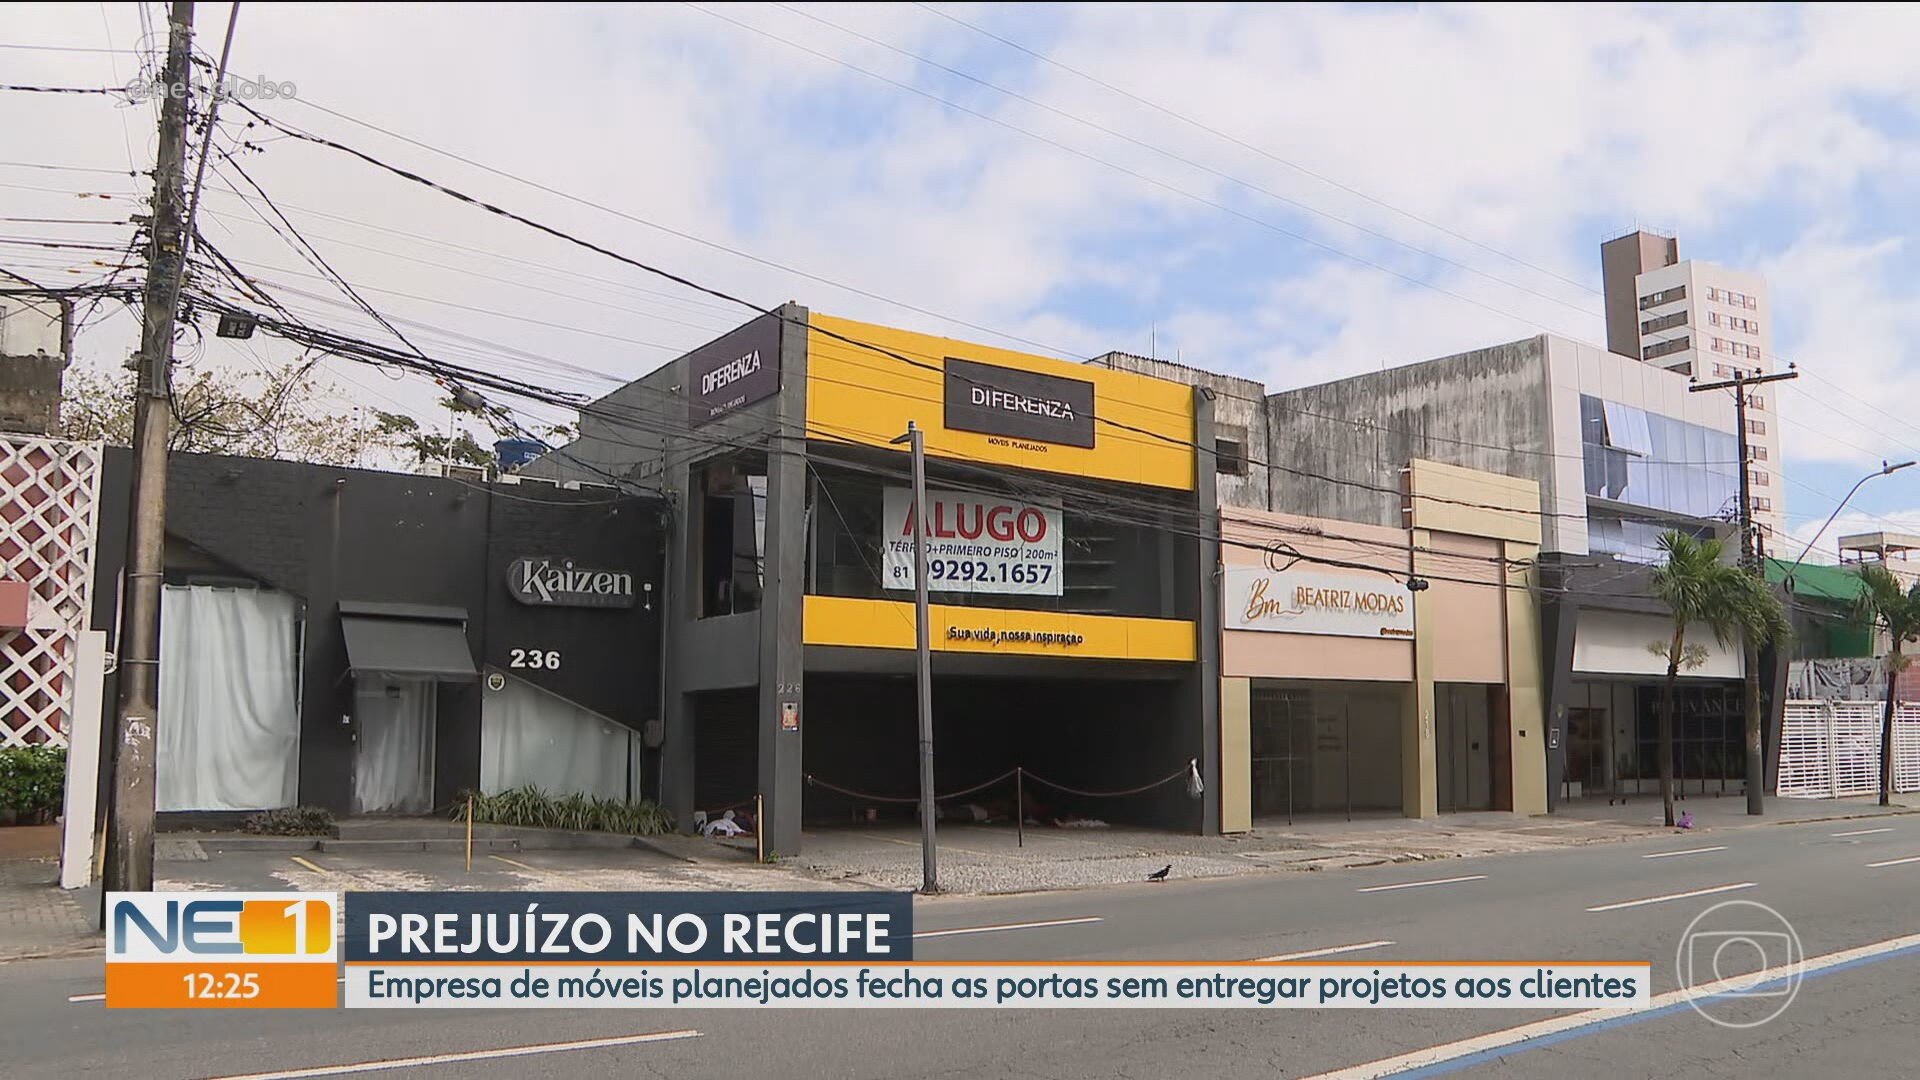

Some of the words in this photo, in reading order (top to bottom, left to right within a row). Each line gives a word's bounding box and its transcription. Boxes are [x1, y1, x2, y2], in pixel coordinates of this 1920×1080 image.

[702, 349, 761, 395] DIFERENZA
[971, 387, 1075, 421] DIFERENZA
[1011, 442, 1048, 453] PLANEJADOS
[993, 547, 1019, 559] PISO
[521, 560, 632, 602] Kaizen
[893, 566, 909, 579] 81
[926, 559, 1053, 584] 9292.1657
[1296, 586, 1350, 609] BEATRIZ
[1354, 592, 1404, 613] MODAS
[949, 626, 971, 639] Sua
[1000, 630, 1031, 641] nossa
[510, 648, 561, 670] 236
[777, 683, 801, 694] 226
